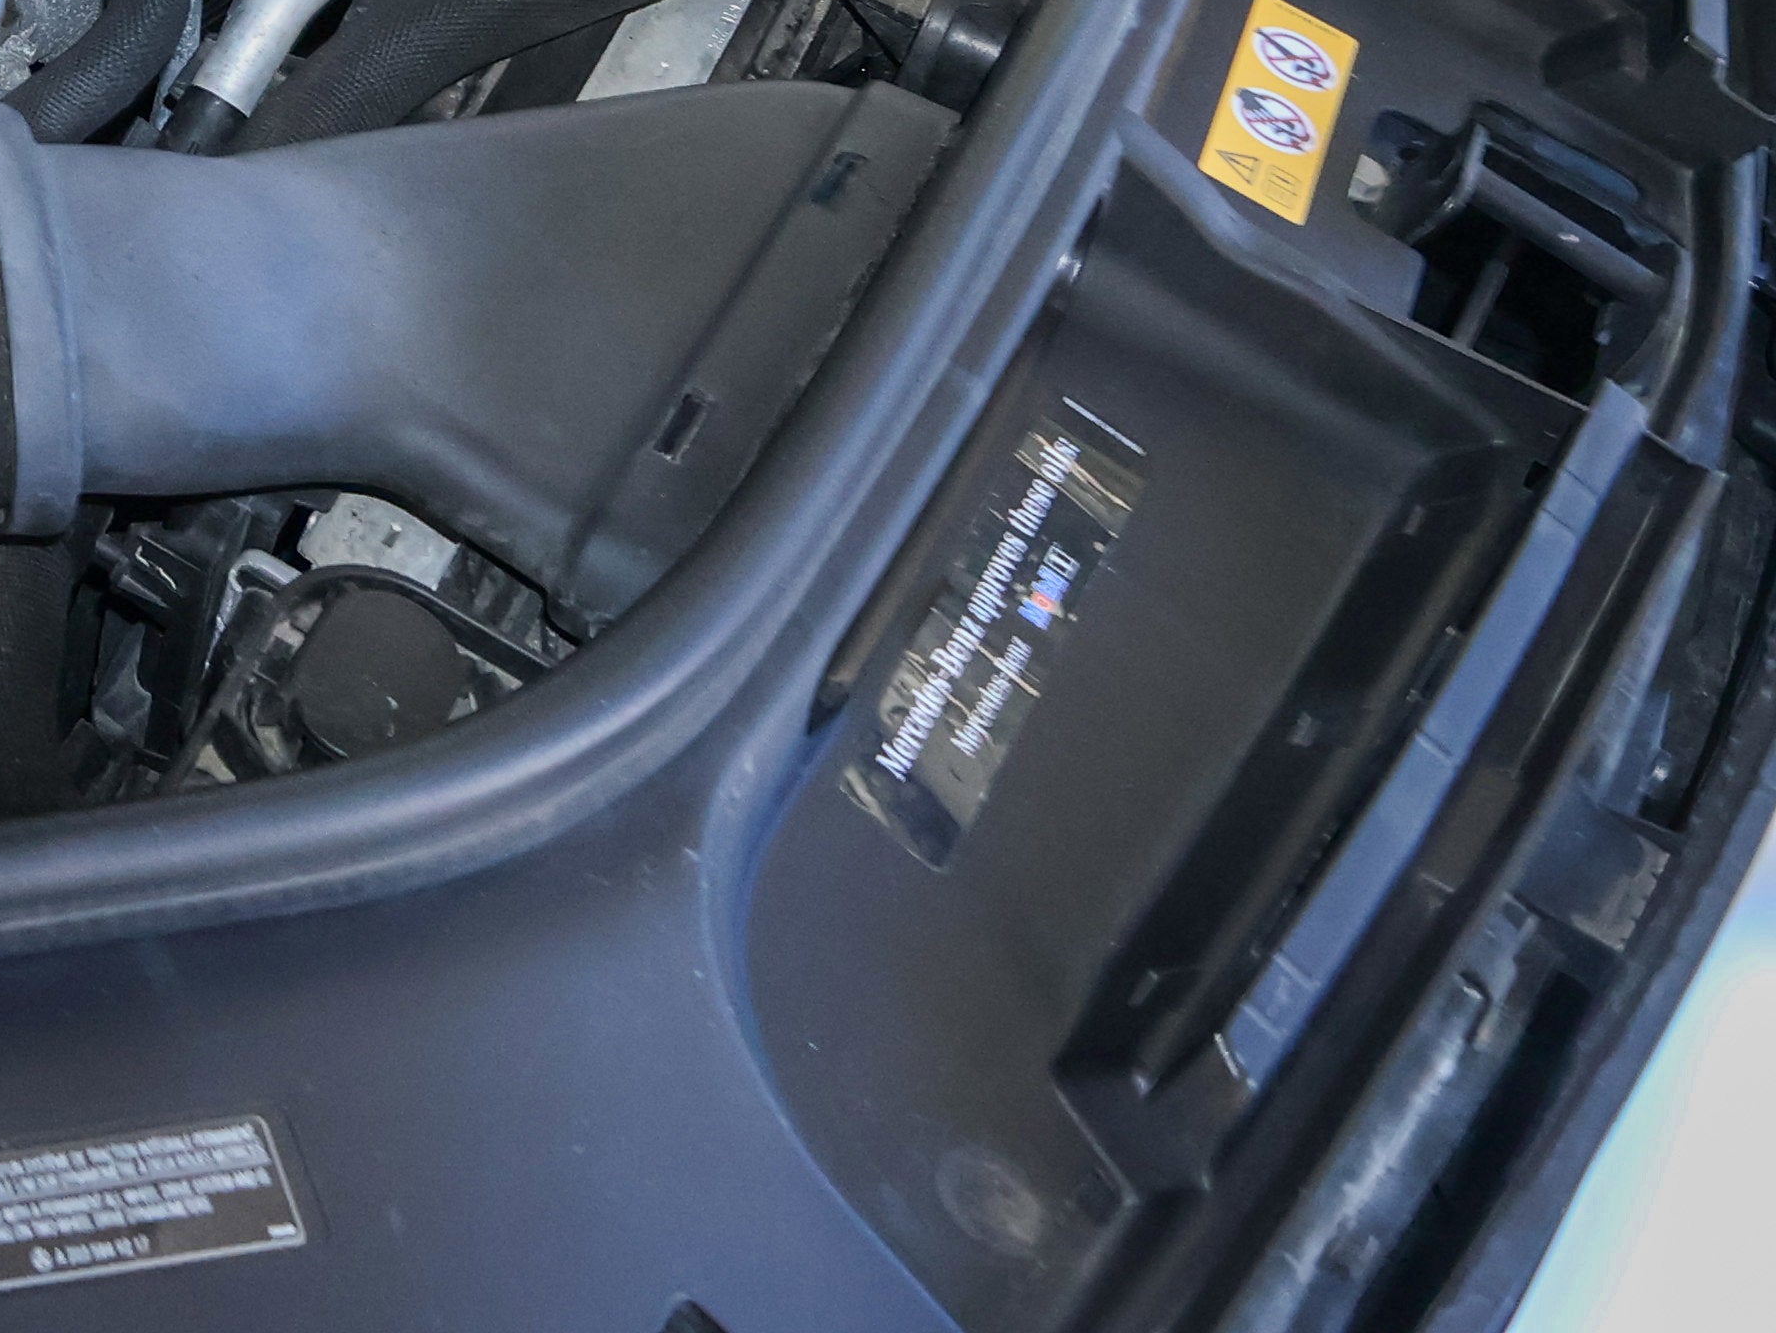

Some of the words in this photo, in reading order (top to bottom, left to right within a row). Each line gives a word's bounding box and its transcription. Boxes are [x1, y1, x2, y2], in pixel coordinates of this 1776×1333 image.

[874, 614, 986, 783] Mercedes-Benz
[967, 531, 1029, 624] approves
[1006, 478, 1059, 538] these
